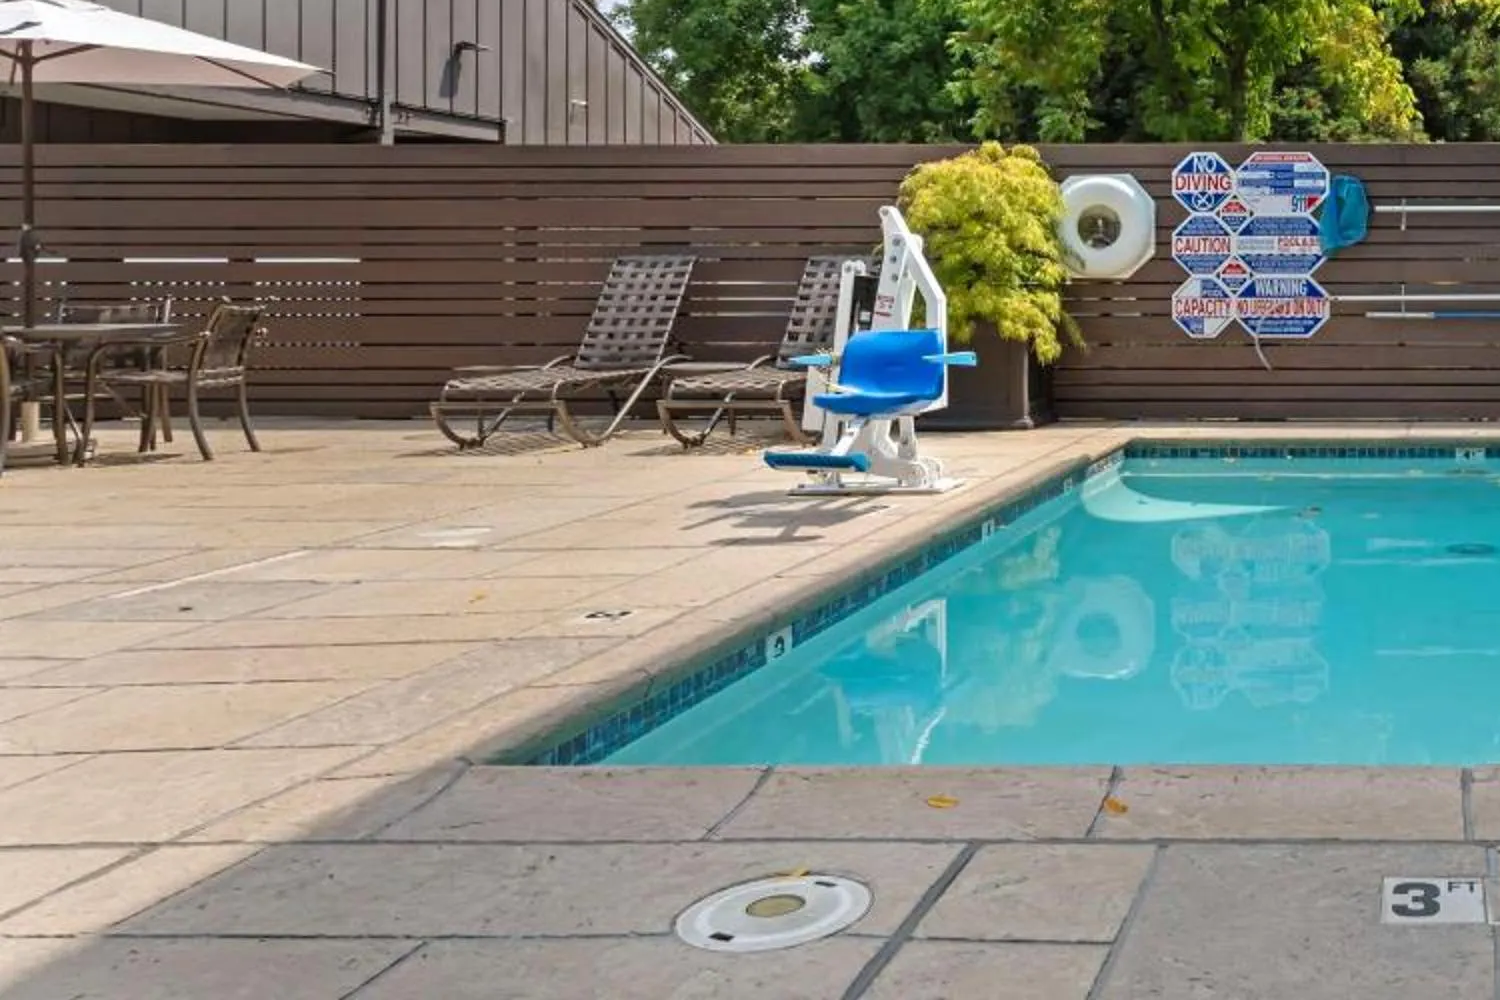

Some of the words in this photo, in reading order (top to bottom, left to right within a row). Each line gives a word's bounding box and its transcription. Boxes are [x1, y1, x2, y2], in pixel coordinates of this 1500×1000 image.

[1193, 155, 1216, 173] NO
[1175, 175, 1232, 191] DIVING
[1175, 237, 1230, 252] CAUTION
[1255, 279, 1307, 297] WARNING
[1175, 299, 1231, 316] CAPACITY
[1392, 881, 1440, 917] 3
[1447, 881, 1477, 893] FT
